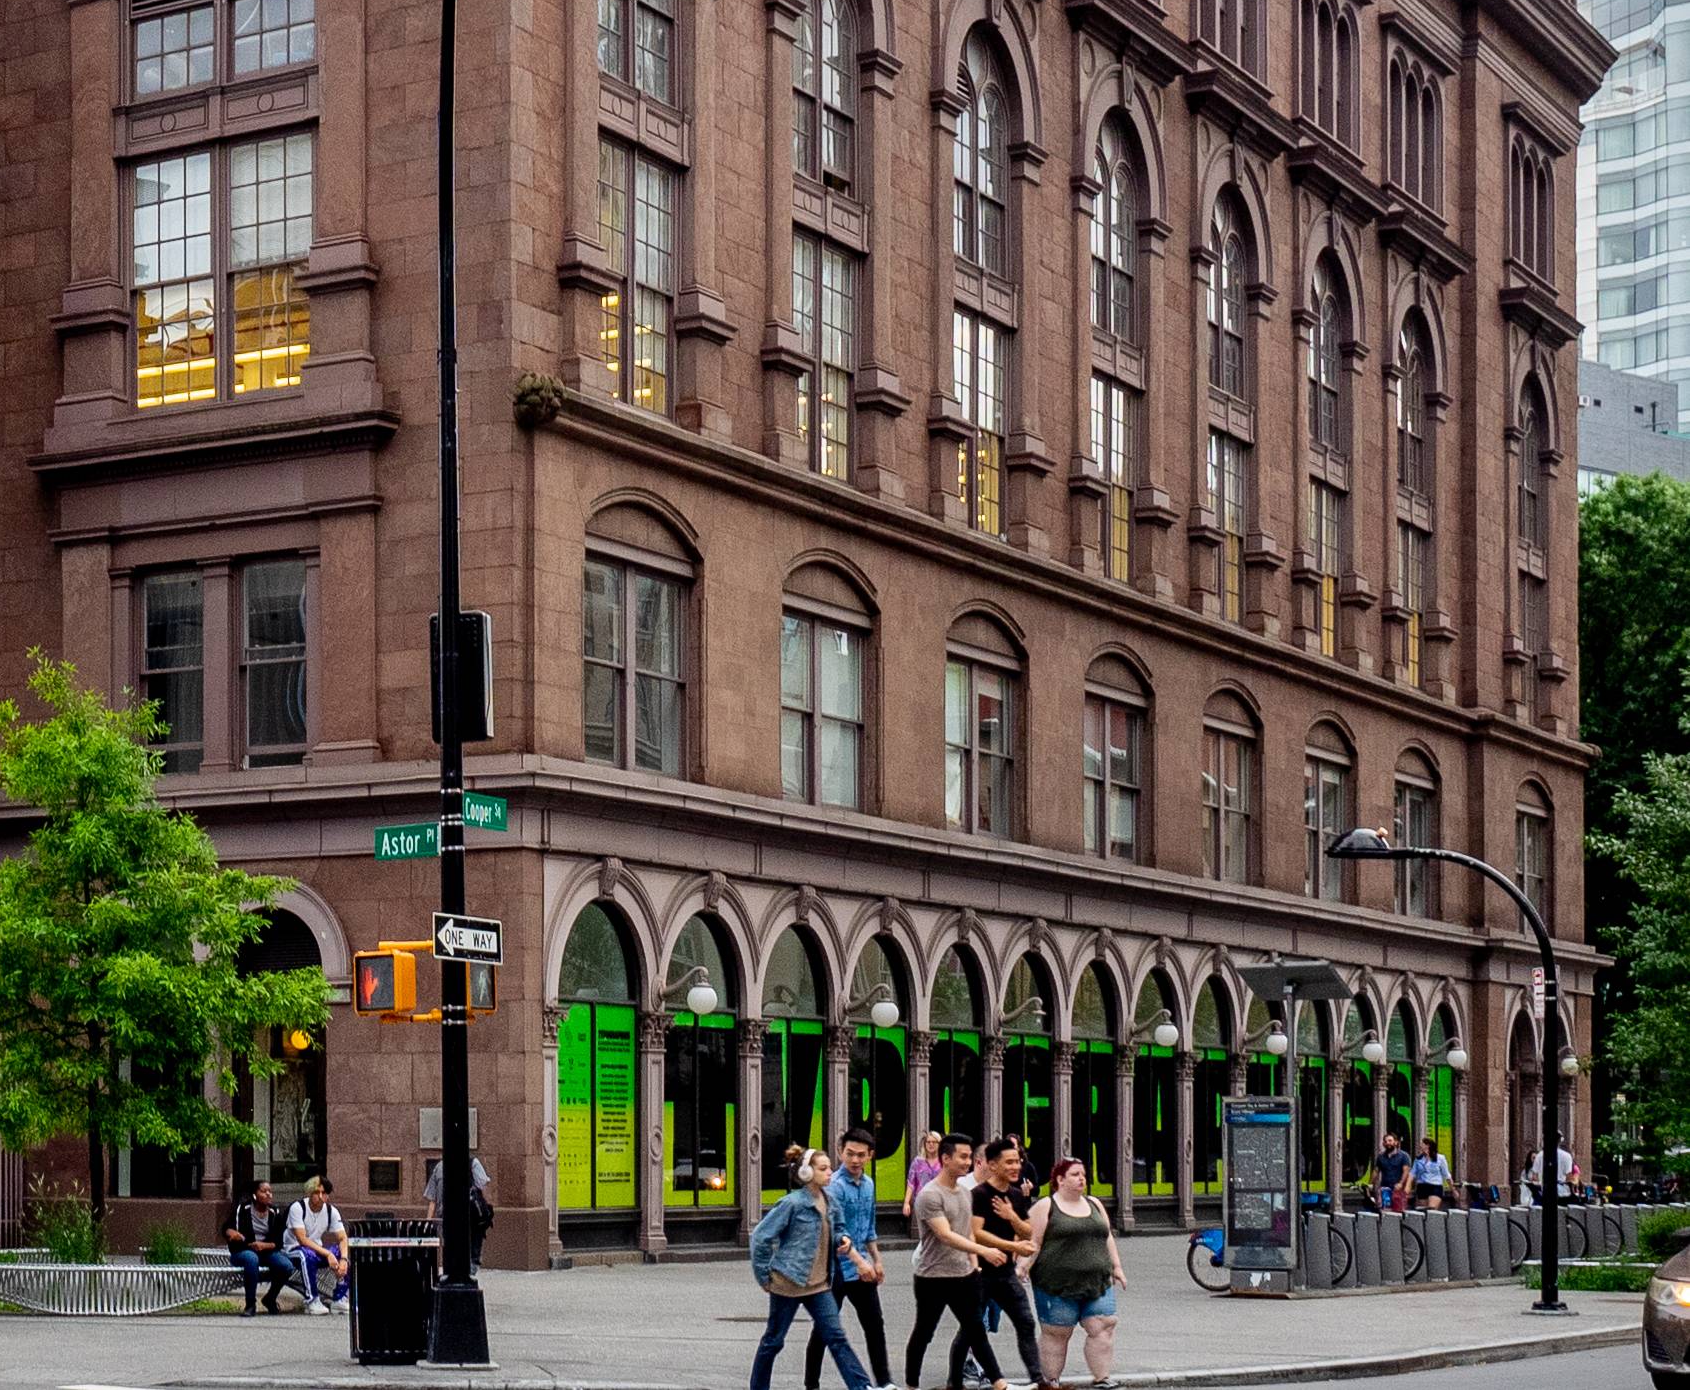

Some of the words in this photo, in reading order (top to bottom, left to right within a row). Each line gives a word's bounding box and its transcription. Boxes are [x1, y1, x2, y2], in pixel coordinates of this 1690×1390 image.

[465, 797, 493, 827] Cooper
[494, 803, 502, 820] Sq
[381, 832, 421, 856] Astor
[426, 828, 435, 843] Pl
[444, 928, 464, 947] ONE
[472, 931, 493, 949] WAY
